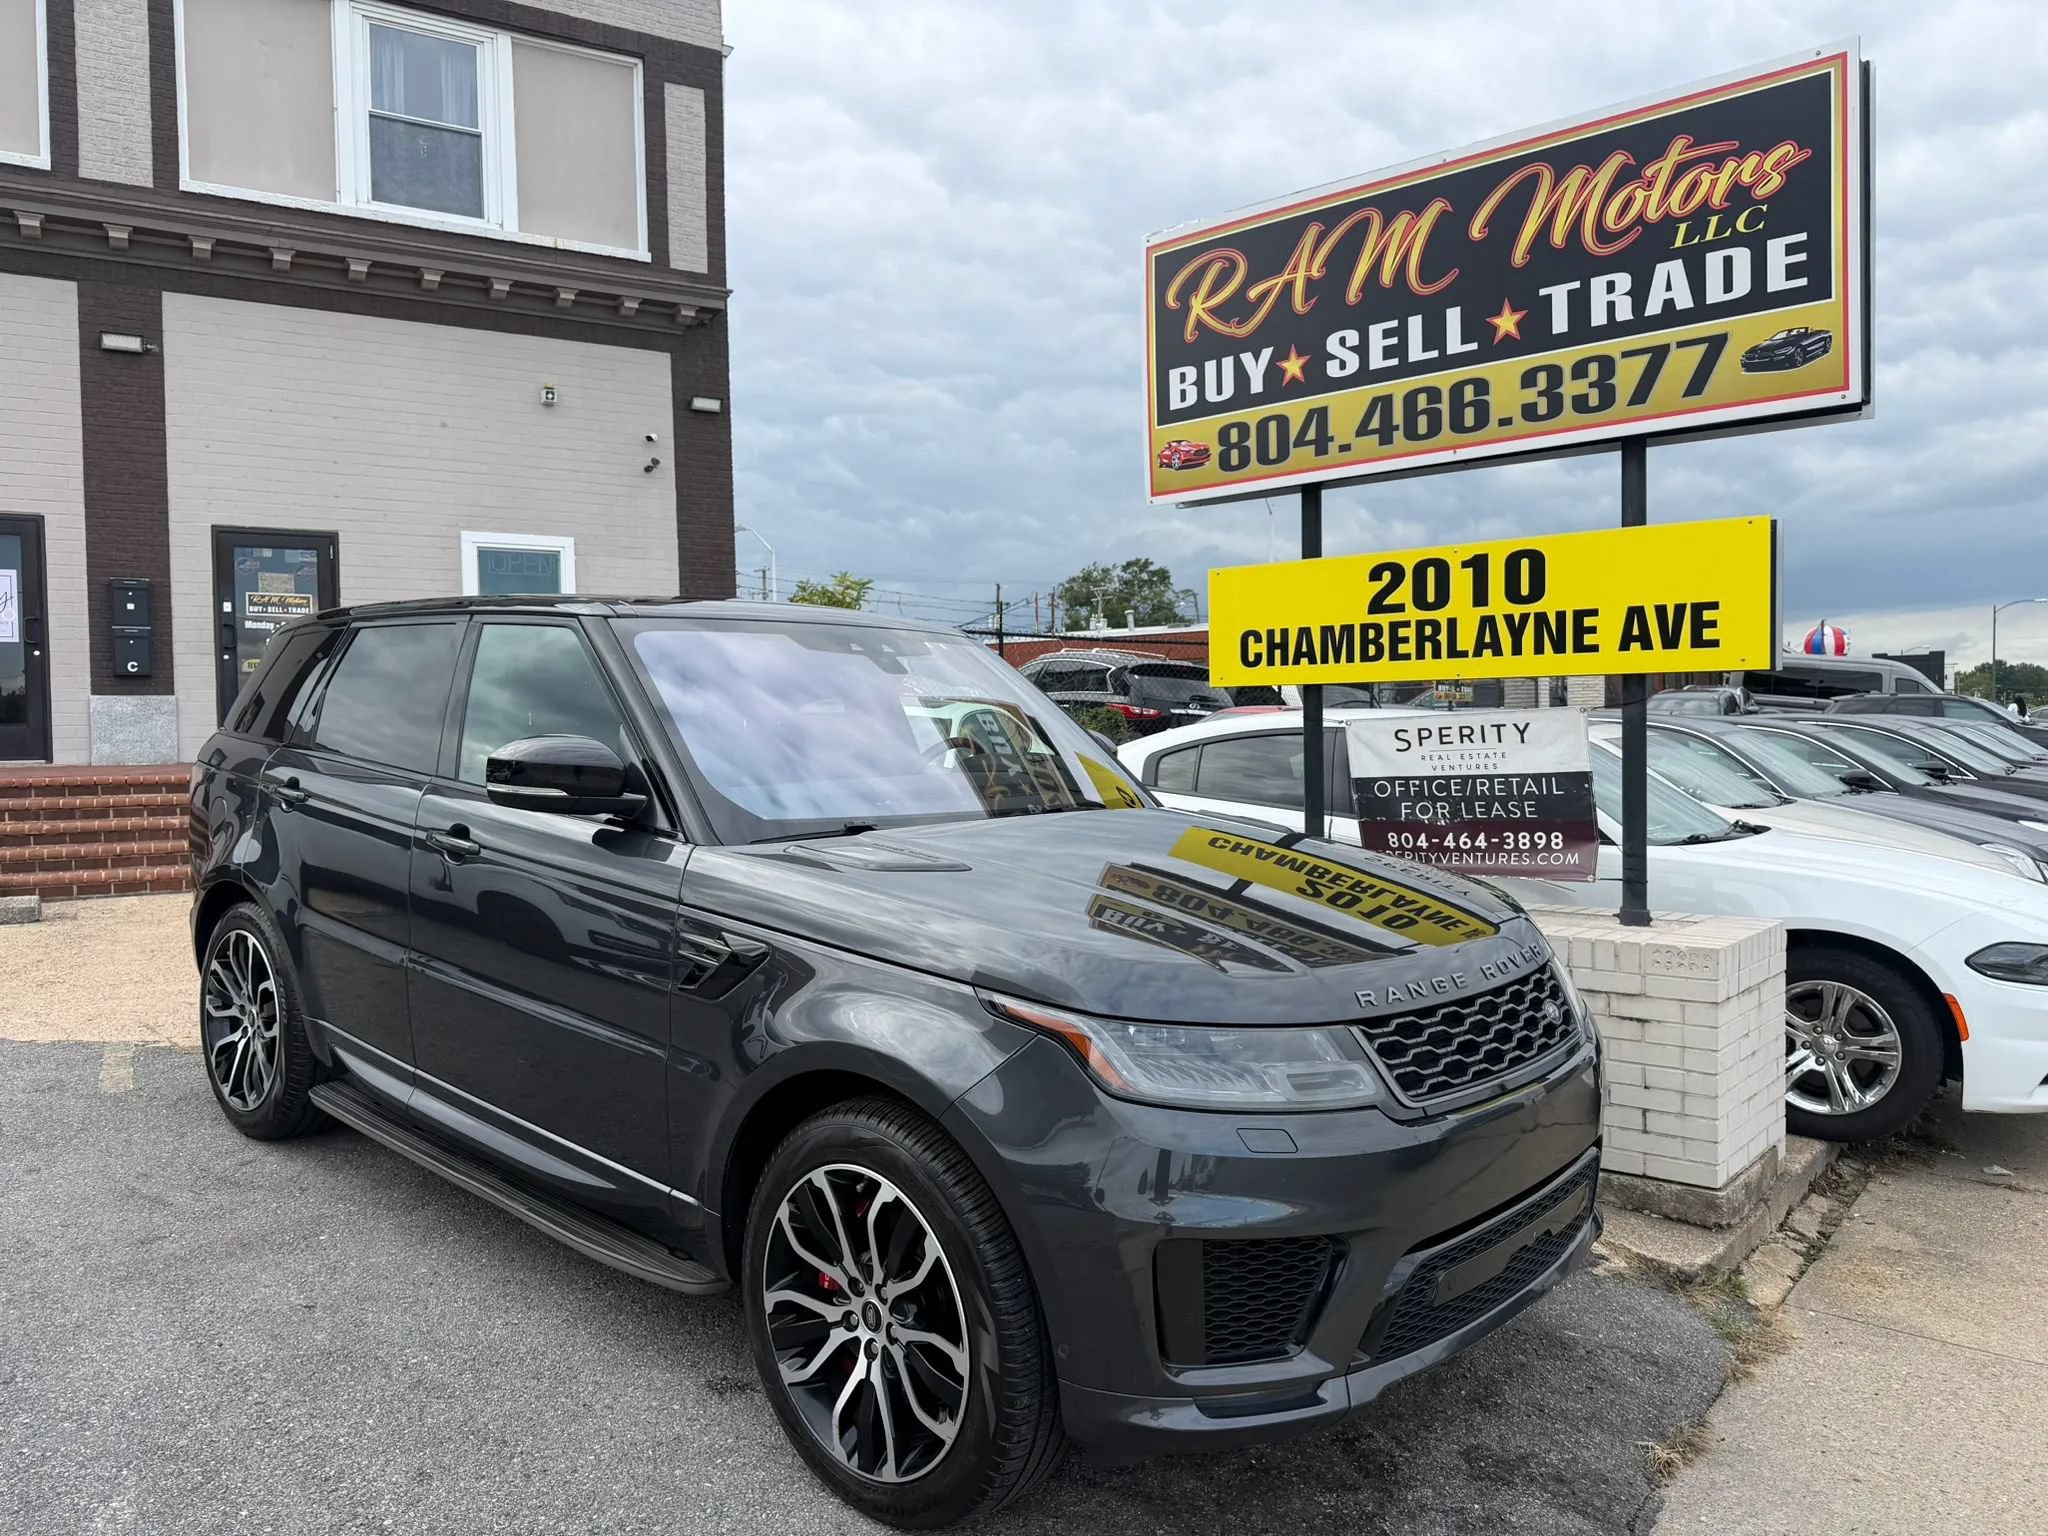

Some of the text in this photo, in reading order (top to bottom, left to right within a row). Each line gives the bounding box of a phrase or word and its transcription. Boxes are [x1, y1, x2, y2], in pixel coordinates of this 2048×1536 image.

[1669, 204, 1768, 249] LLC
[1166, 134, 1812, 343] RAM Motors
[1168, 231, 1809, 411] BUY SELL TRADE
[1217, 331, 1731, 473] 804.466.3377
[491, 552, 553, 574] OPEN
[1367, 548, 1546, 615] 2010
[244, 620, 274, 631] Monday
[1240, 601, 1720, 669] CHAMBERLAYNE AVE
[127, 661, 138, 672] C
[1394, 722, 1531, 752] SPERITY
[1431, 763, 1498, 771] VENTURES
[1460, 752, 1507, 760] ESTATE
[1374, 776, 1565, 798] OFFICE/RETAIL
[1401, 801, 1538, 819] FOR LEASE
[1387, 831, 1564, 850] 804-464-3898
[1380, 849, 1580, 866] RITYVENTURES.COM
[1355, 944, 1542, 1009] RANGE ROVER
